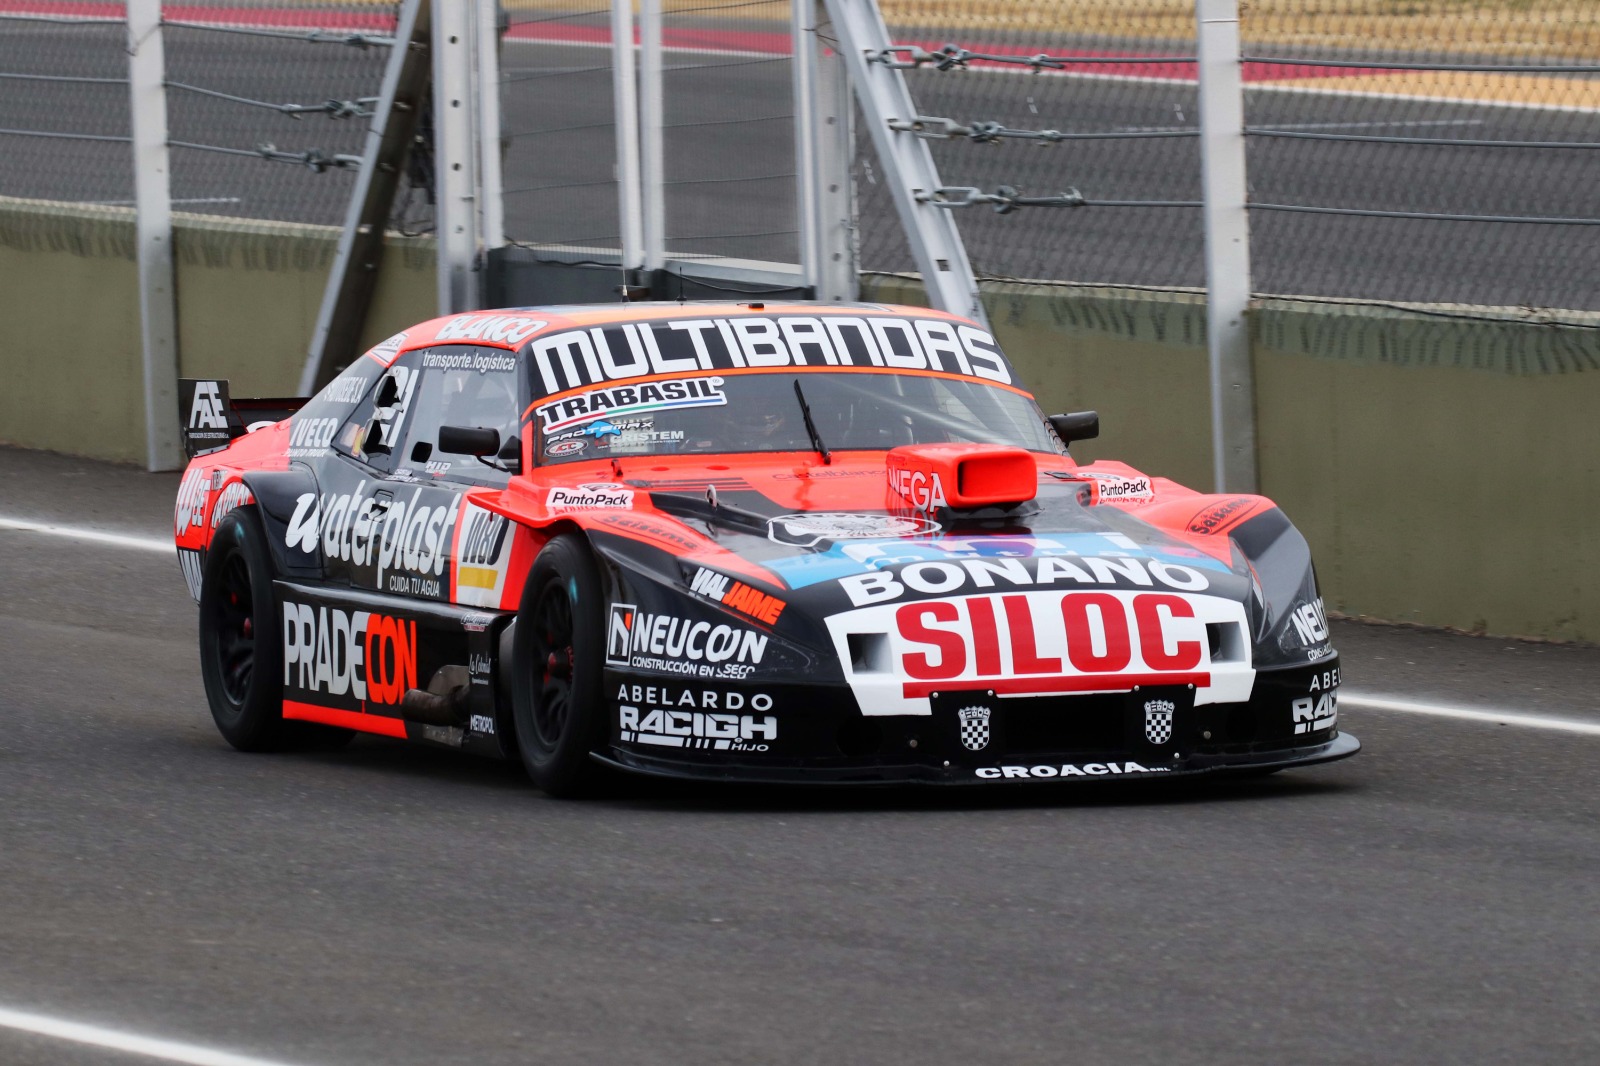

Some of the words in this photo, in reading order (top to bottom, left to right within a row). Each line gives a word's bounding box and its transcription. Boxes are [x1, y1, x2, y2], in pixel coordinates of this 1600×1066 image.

[435, 315, 548, 344] BLANCO
[422, 352, 516, 373] transporte.logística
[531, 316, 1012, 395] MULTIBANDAS
[541, 379, 721, 423] TRABASIL
[289, 418, 339, 447] IVECO
[610, 431, 684, 445] CRISTEM
[552, 491, 628, 506] PuntoPack
[888, 465, 949, 513] WEGA
[1100, 480, 1147, 497] PuntoPack
[285, 480, 462, 590] waterplast
[389, 575, 410, 594] CUIDA
[411, 577, 420, 594] TU
[420, 580, 440, 597] AGUA
[838, 556, 1209, 607] BONANO
[633, 612, 769, 664] NEUCON
[895, 593, 1202, 680] SILOC
[283, 601, 418, 706] PRADECON
[632, 656, 697, 676] CONSTRUCCIÓN
[699, 665, 714, 677] EN
[618, 684, 773, 711] ABELARDO
[731, 743, 770, 752] HIJO
[975, 761, 1150, 779] CROACIA
